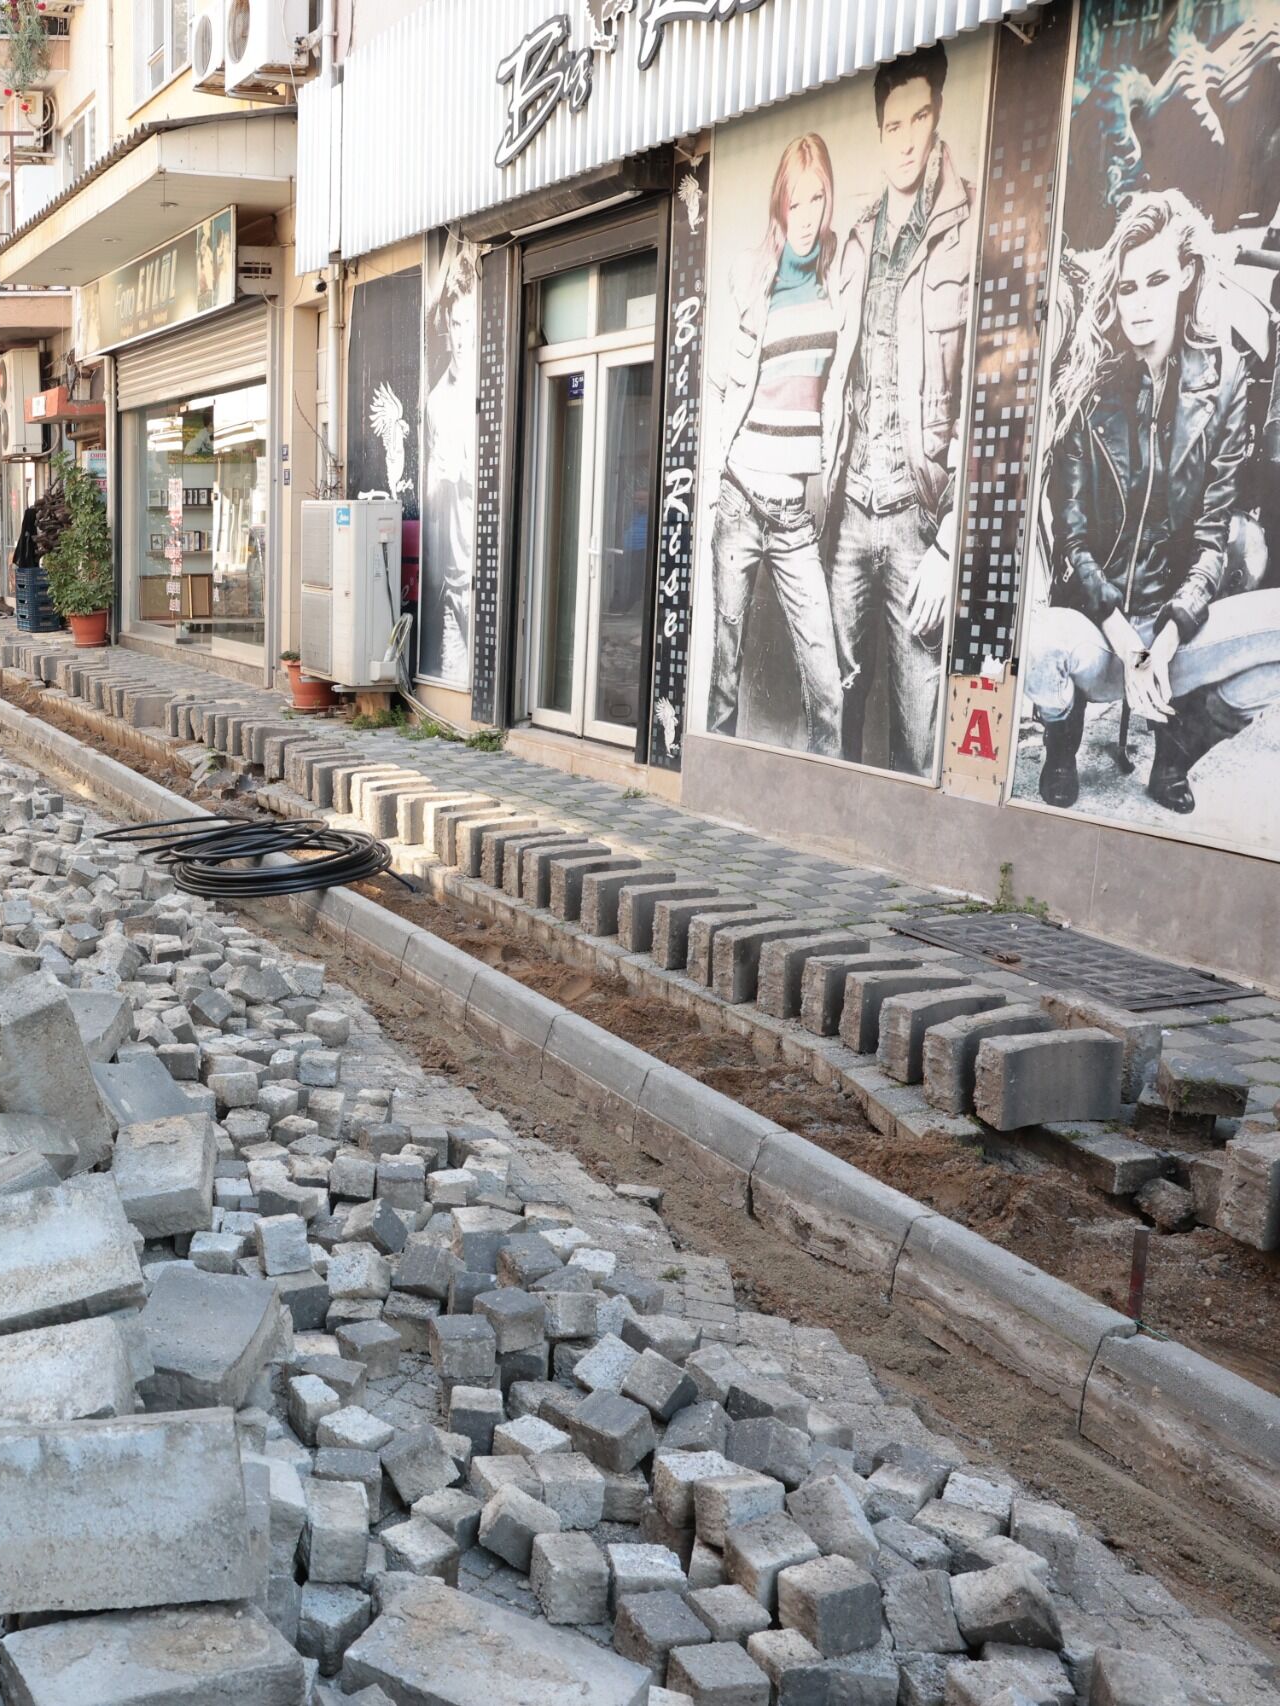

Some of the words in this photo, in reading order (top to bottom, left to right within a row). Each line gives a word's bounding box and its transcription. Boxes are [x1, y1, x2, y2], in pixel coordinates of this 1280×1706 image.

[495, 14, 594, 168] Big
[671, 296, 701, 448] Big
[664, 467, 694, 638] Rise
